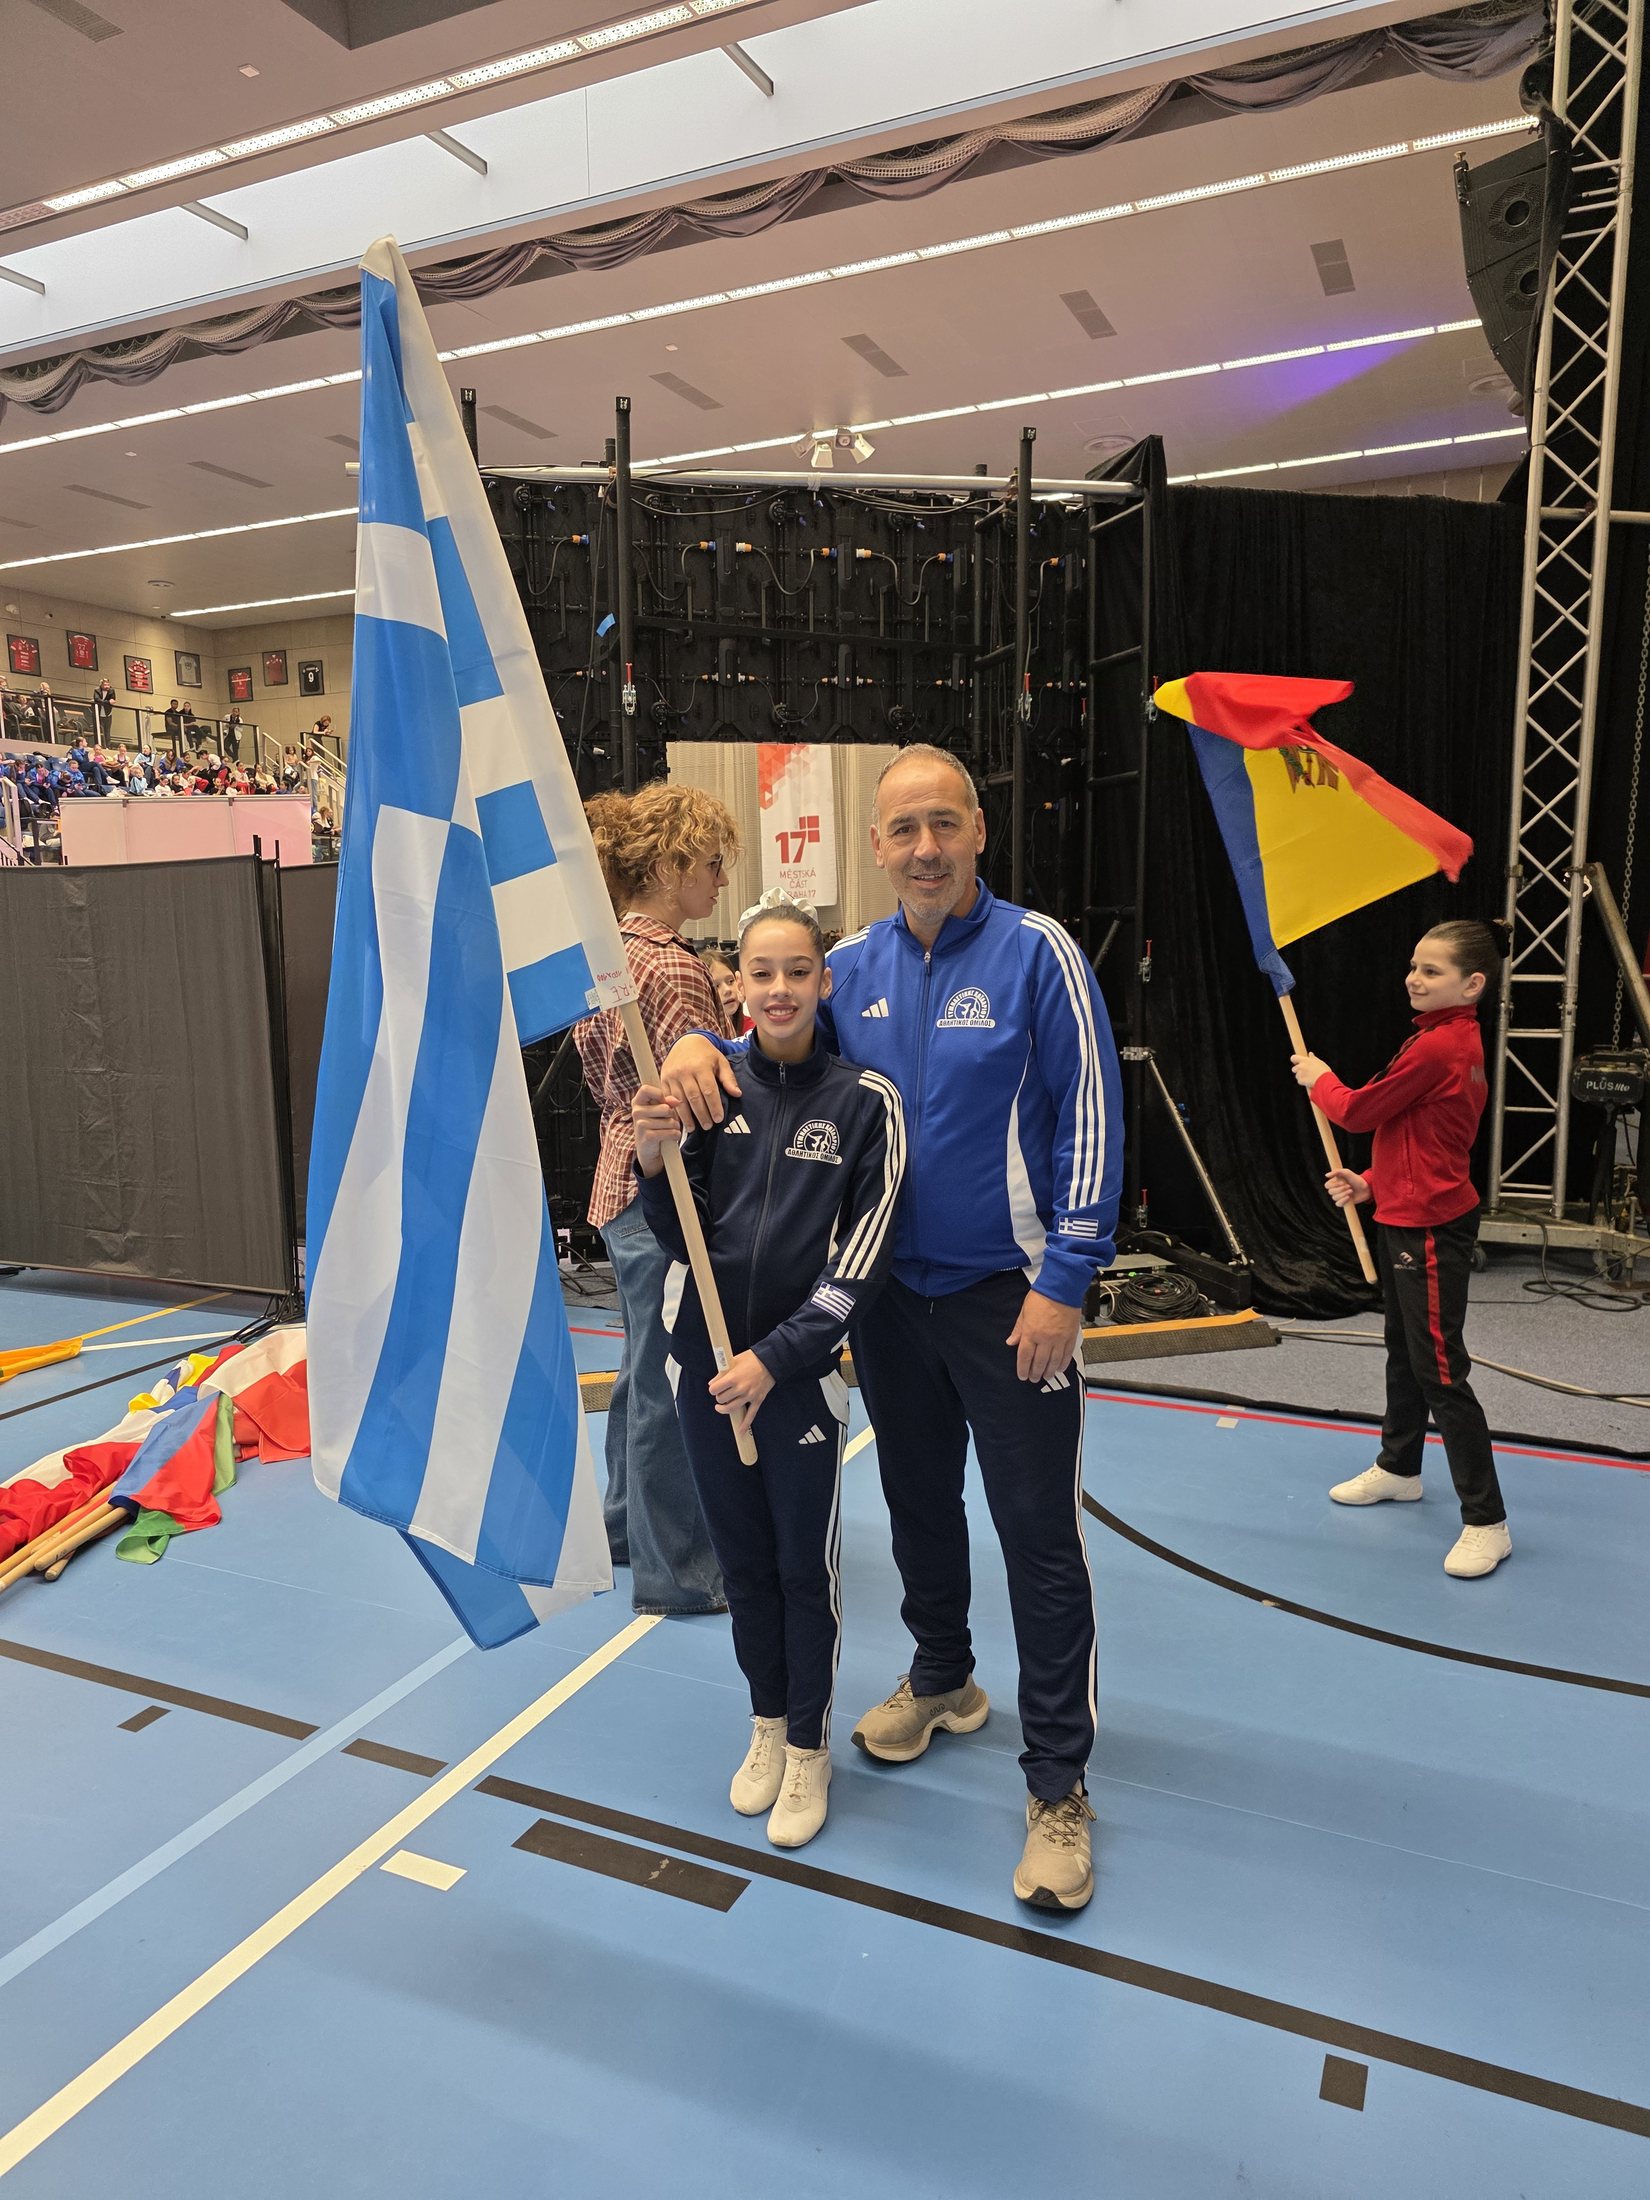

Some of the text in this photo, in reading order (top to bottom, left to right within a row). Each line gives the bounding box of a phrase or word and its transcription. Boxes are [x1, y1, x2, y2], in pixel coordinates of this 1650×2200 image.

[308, 671, 314, 683] 9
[775, 831, 807, 864] 17
[779, 867, 817, 879] MĚSTSKÁ
[789, 879, 808, 889] ČÁST
[807, 889, 817, 899] 17
